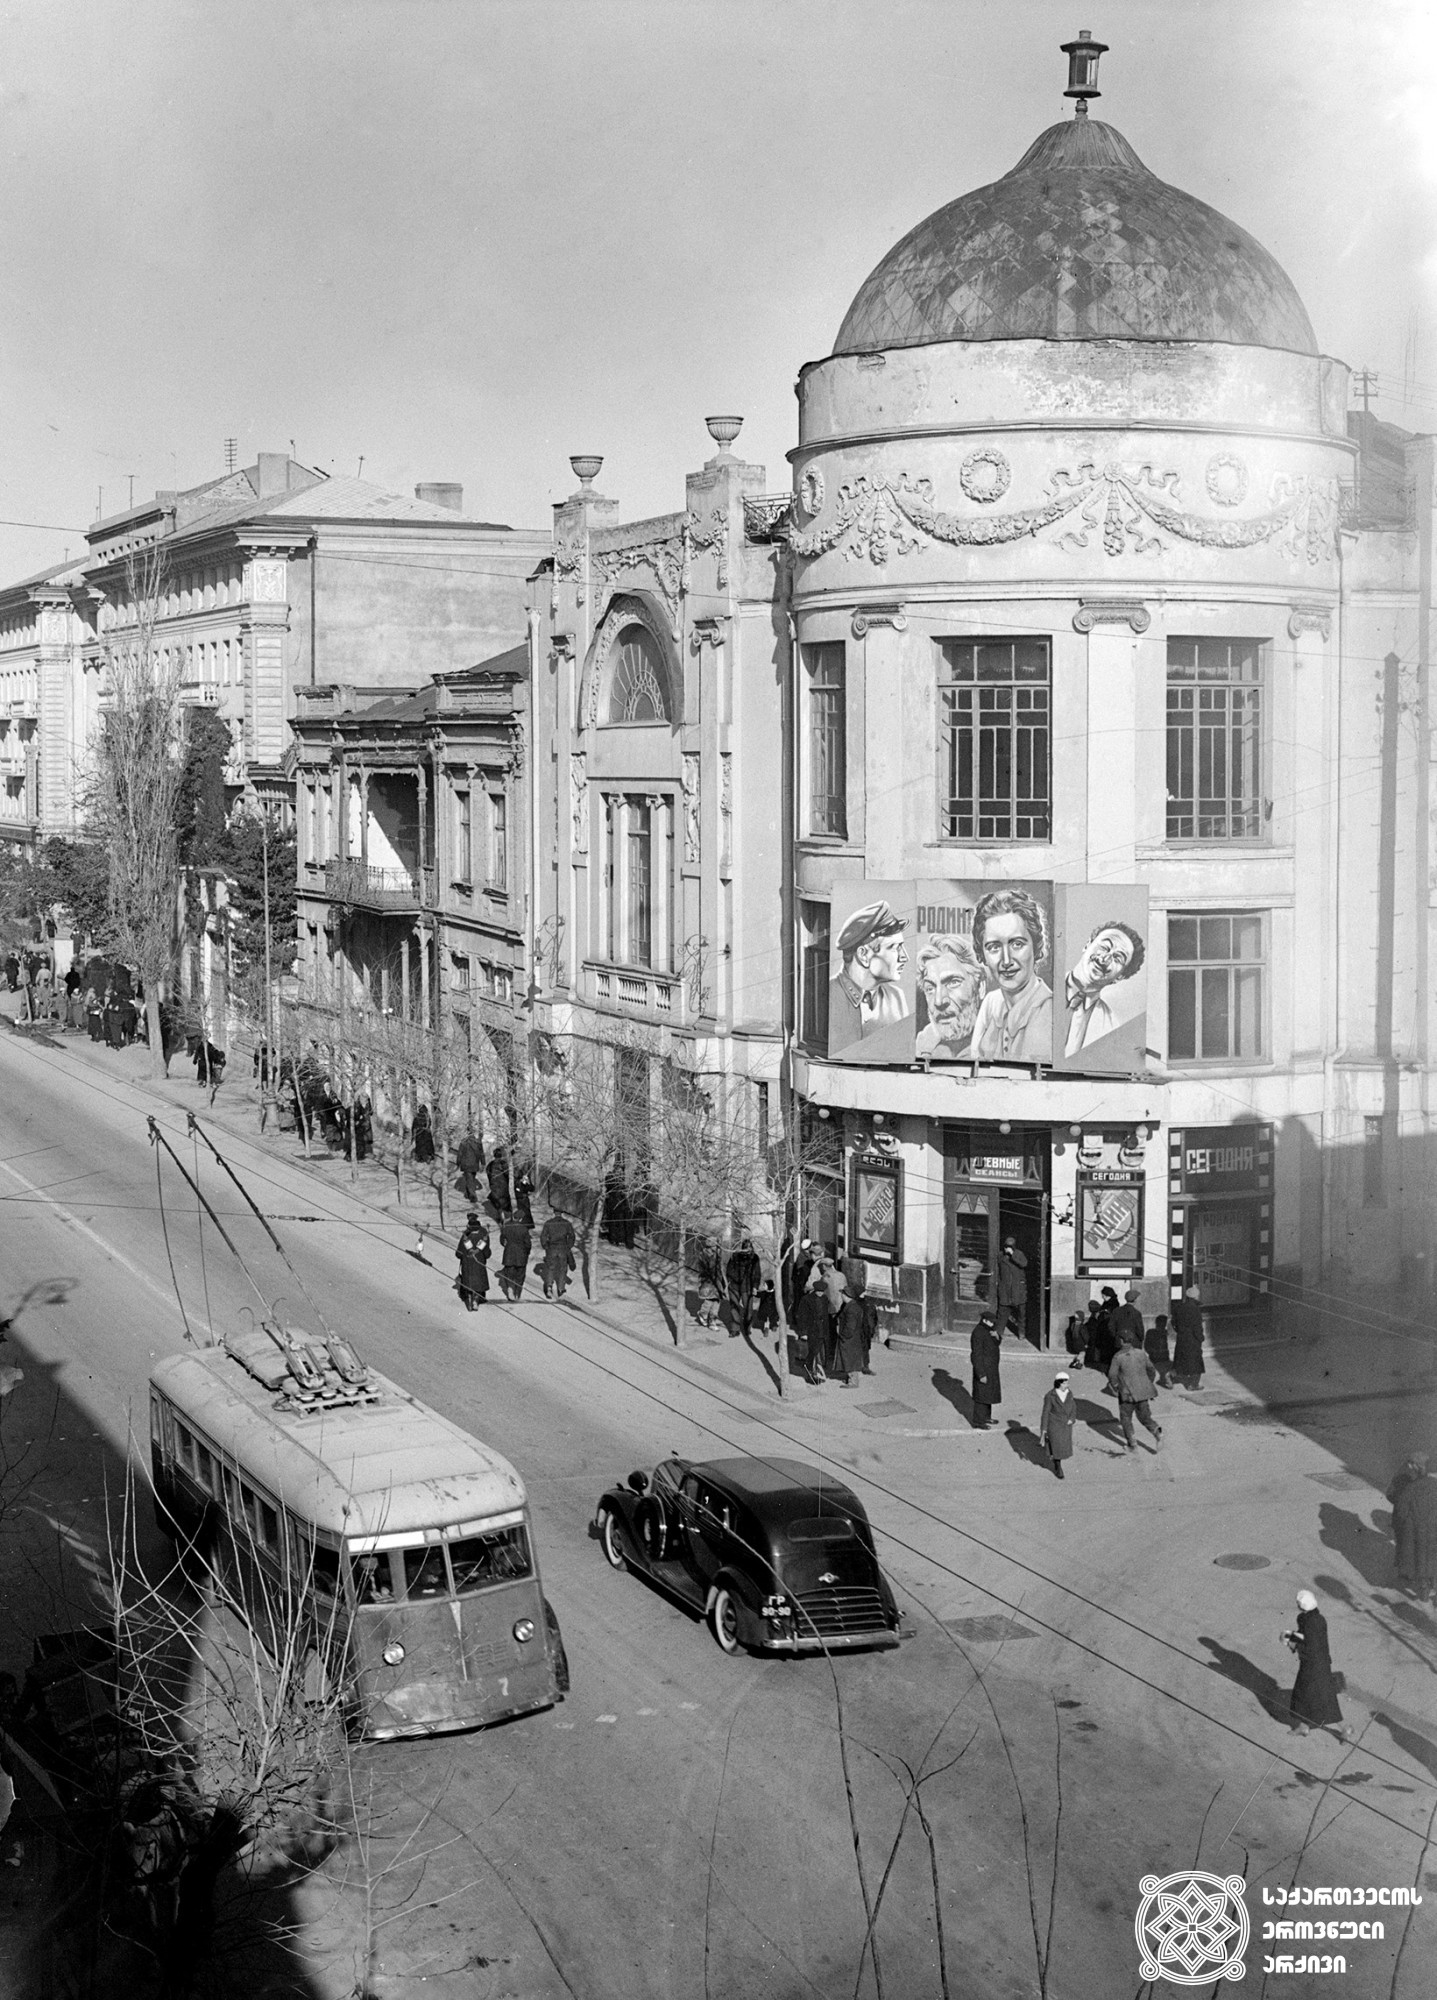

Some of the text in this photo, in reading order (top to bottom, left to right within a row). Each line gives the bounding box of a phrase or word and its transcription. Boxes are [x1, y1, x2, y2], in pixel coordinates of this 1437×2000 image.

[1186, 1147, 1253, 1175] СЕГОДНЯ
[975, 1169, 1018, 1178] СЕАНСЫ
[1092, 1172, 1131, 1181] СЕГОДНЯ
[769, 1595, 786, 1606] ГР
